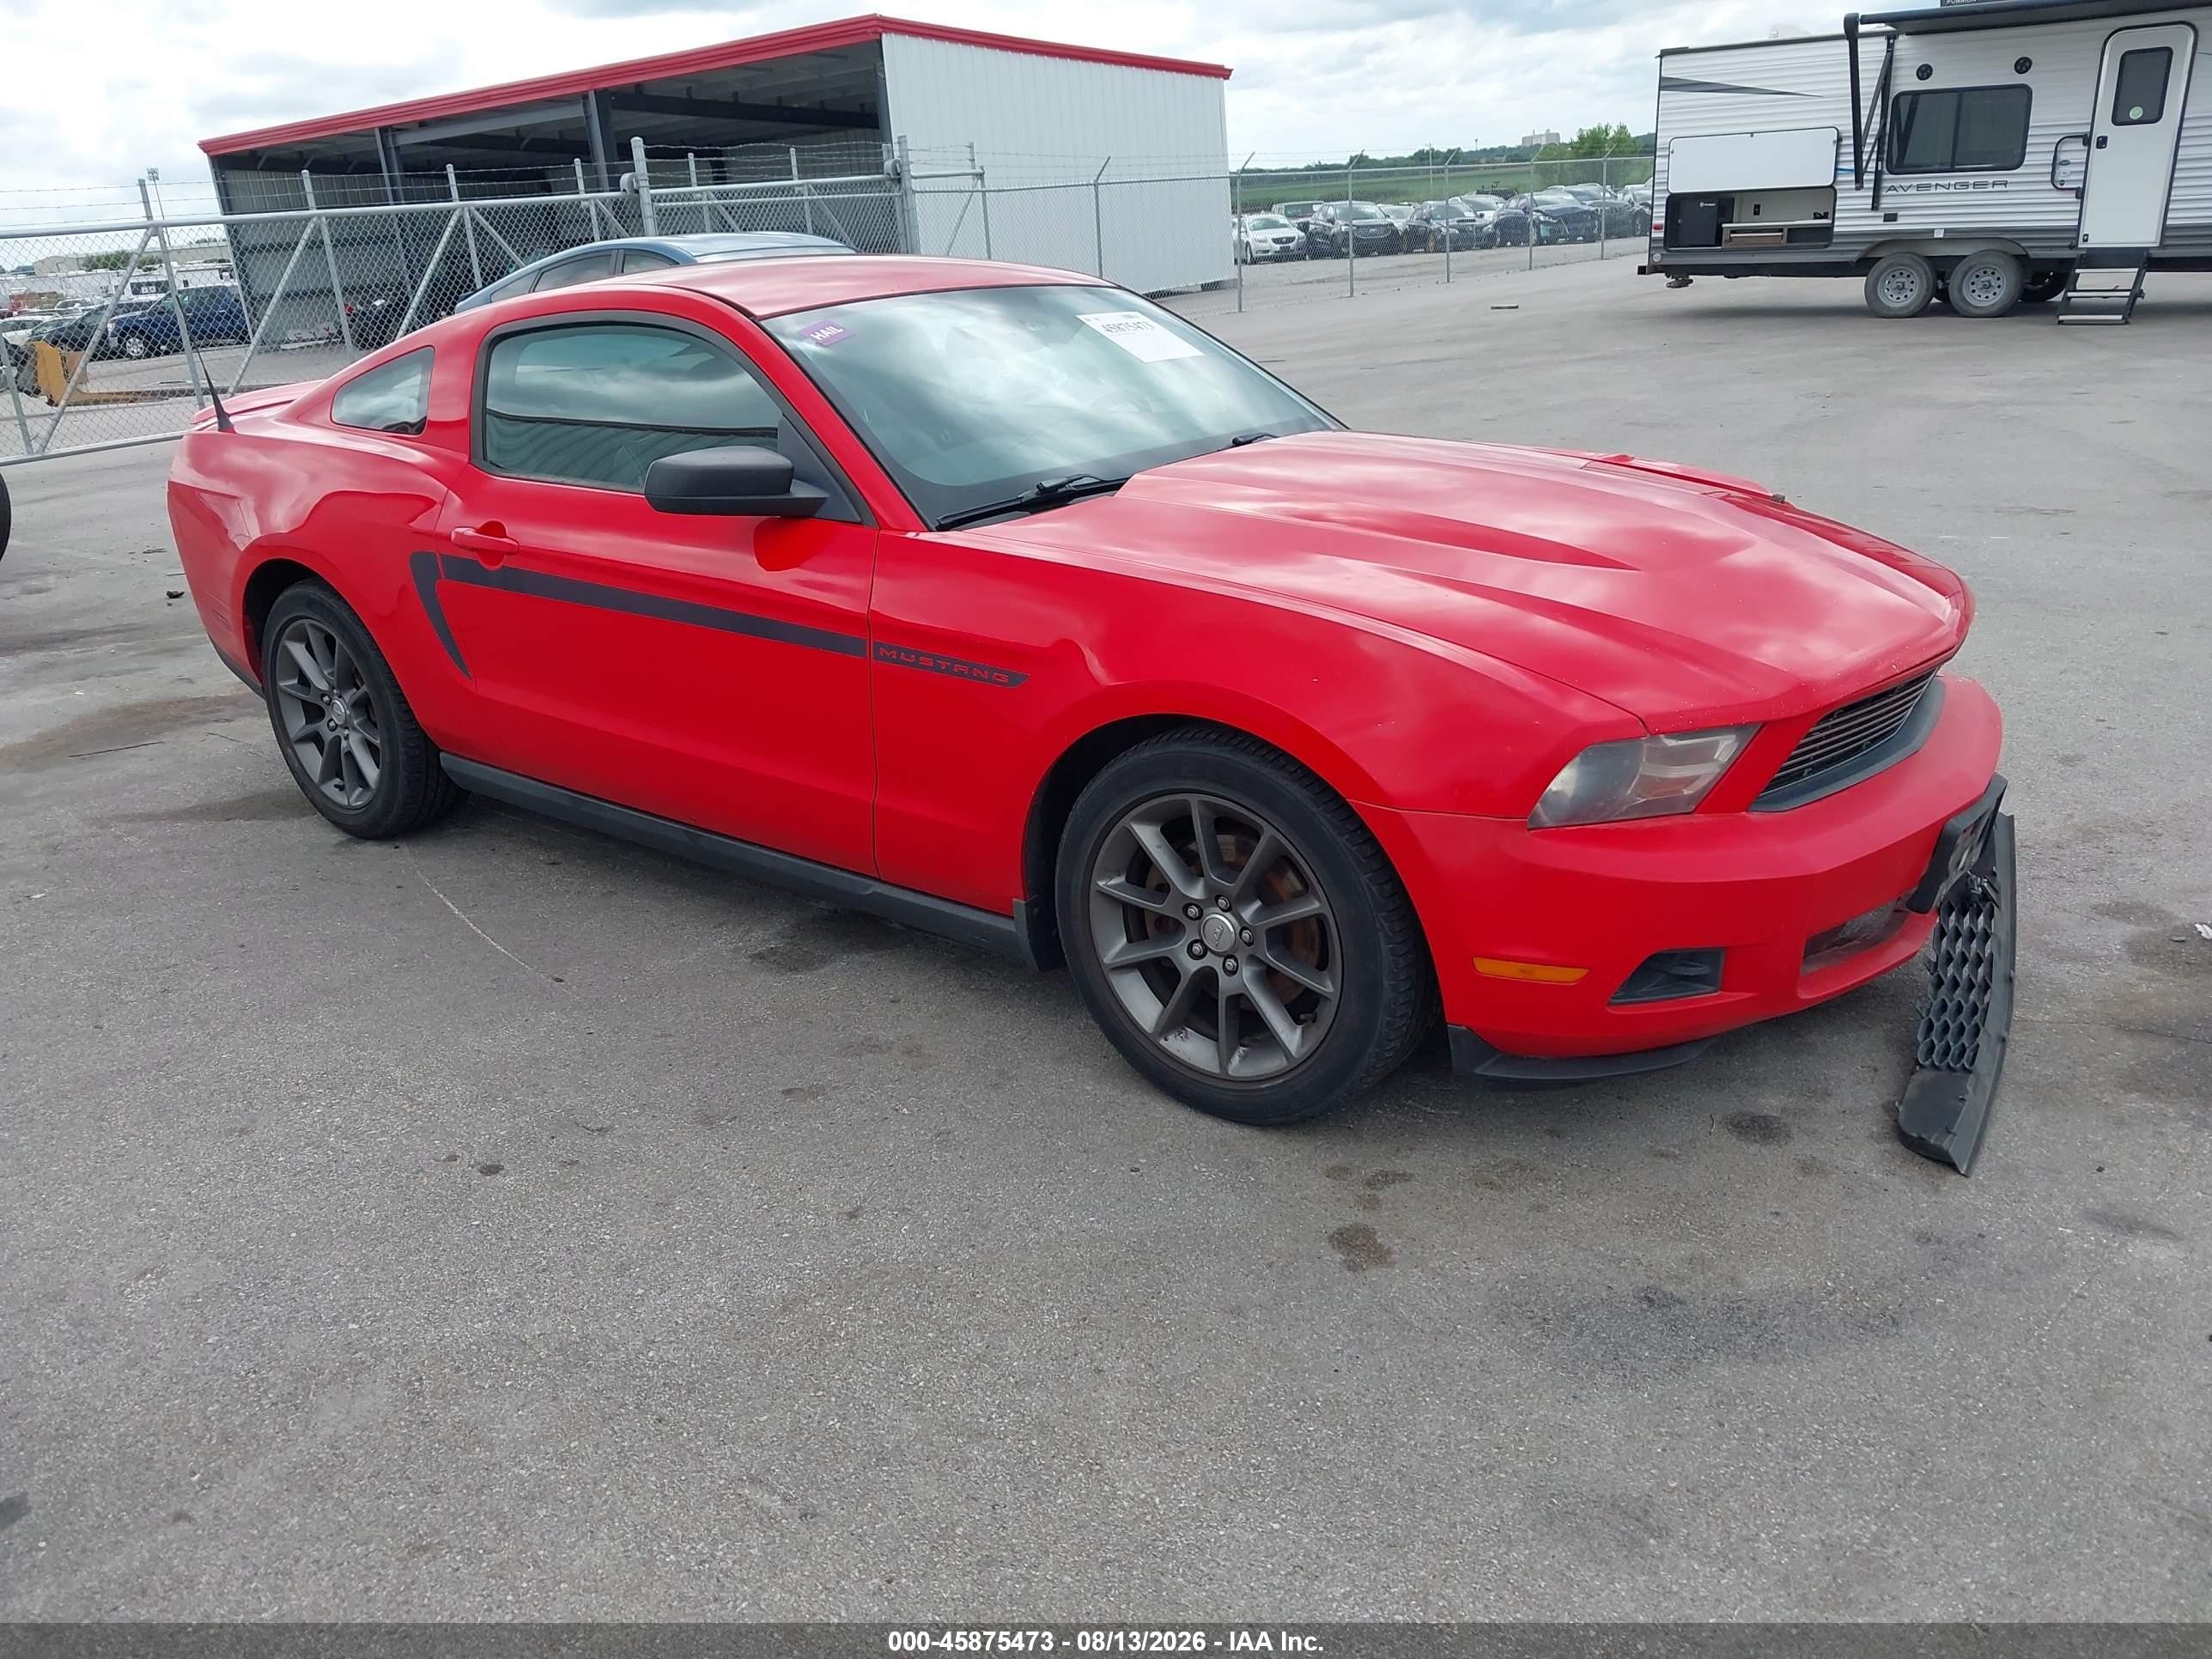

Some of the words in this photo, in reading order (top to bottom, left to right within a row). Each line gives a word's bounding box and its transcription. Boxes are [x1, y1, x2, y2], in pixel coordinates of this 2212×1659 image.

[1886, 179, 2008, 192] AVENGER
[810, 325, 844, 341] HAIL
[878, 647, 1010, 684] MUSTANG
